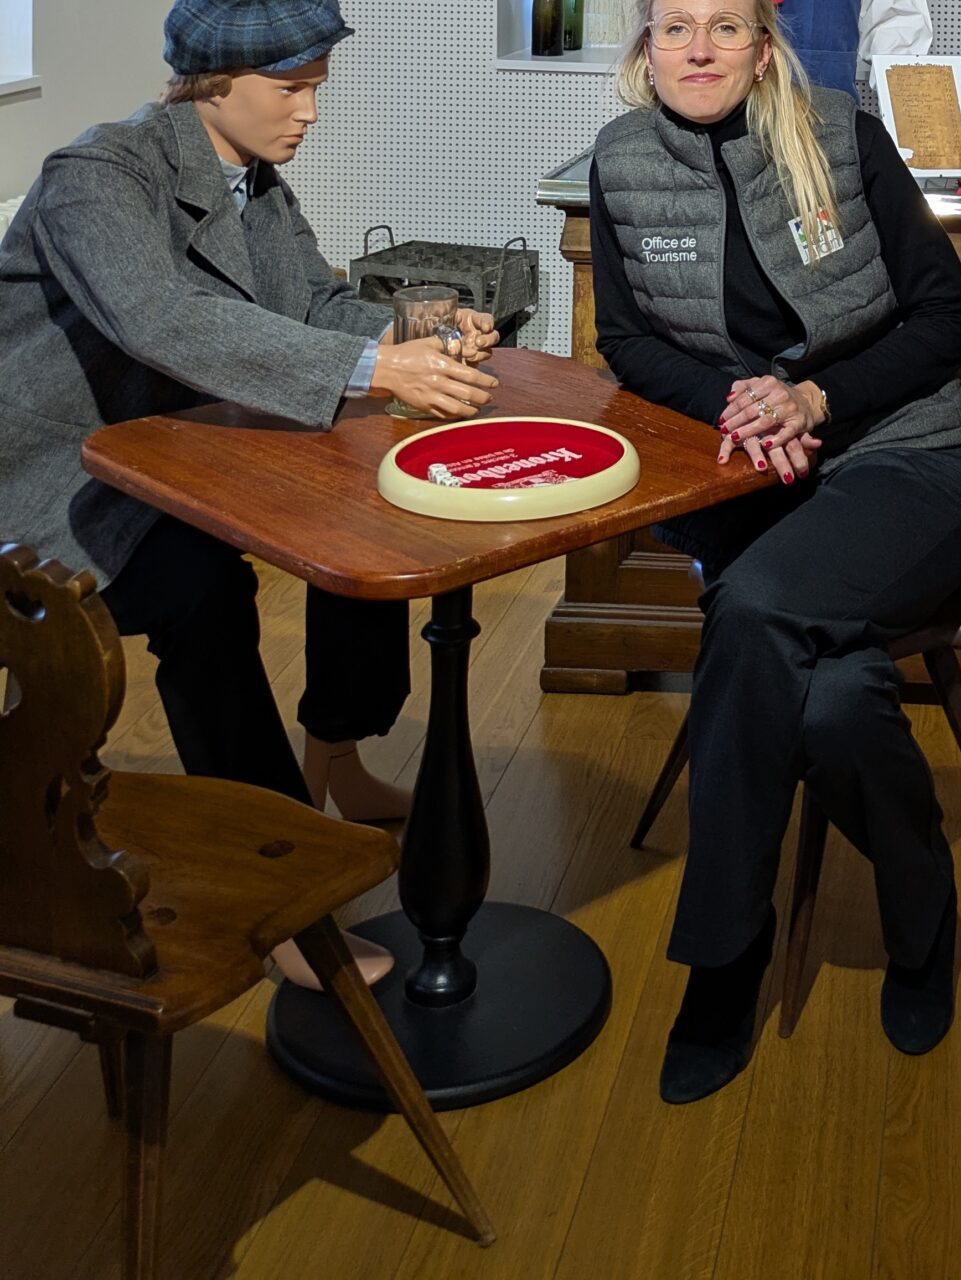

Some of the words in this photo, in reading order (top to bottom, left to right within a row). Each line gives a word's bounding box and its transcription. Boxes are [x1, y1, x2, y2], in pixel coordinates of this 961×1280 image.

[641, 237, 679, 250] Office
[680, 236, 697, 248] de
[642, 251, 697, 263] Tourisme
[458, 447, 583, 485] Kronenbo
